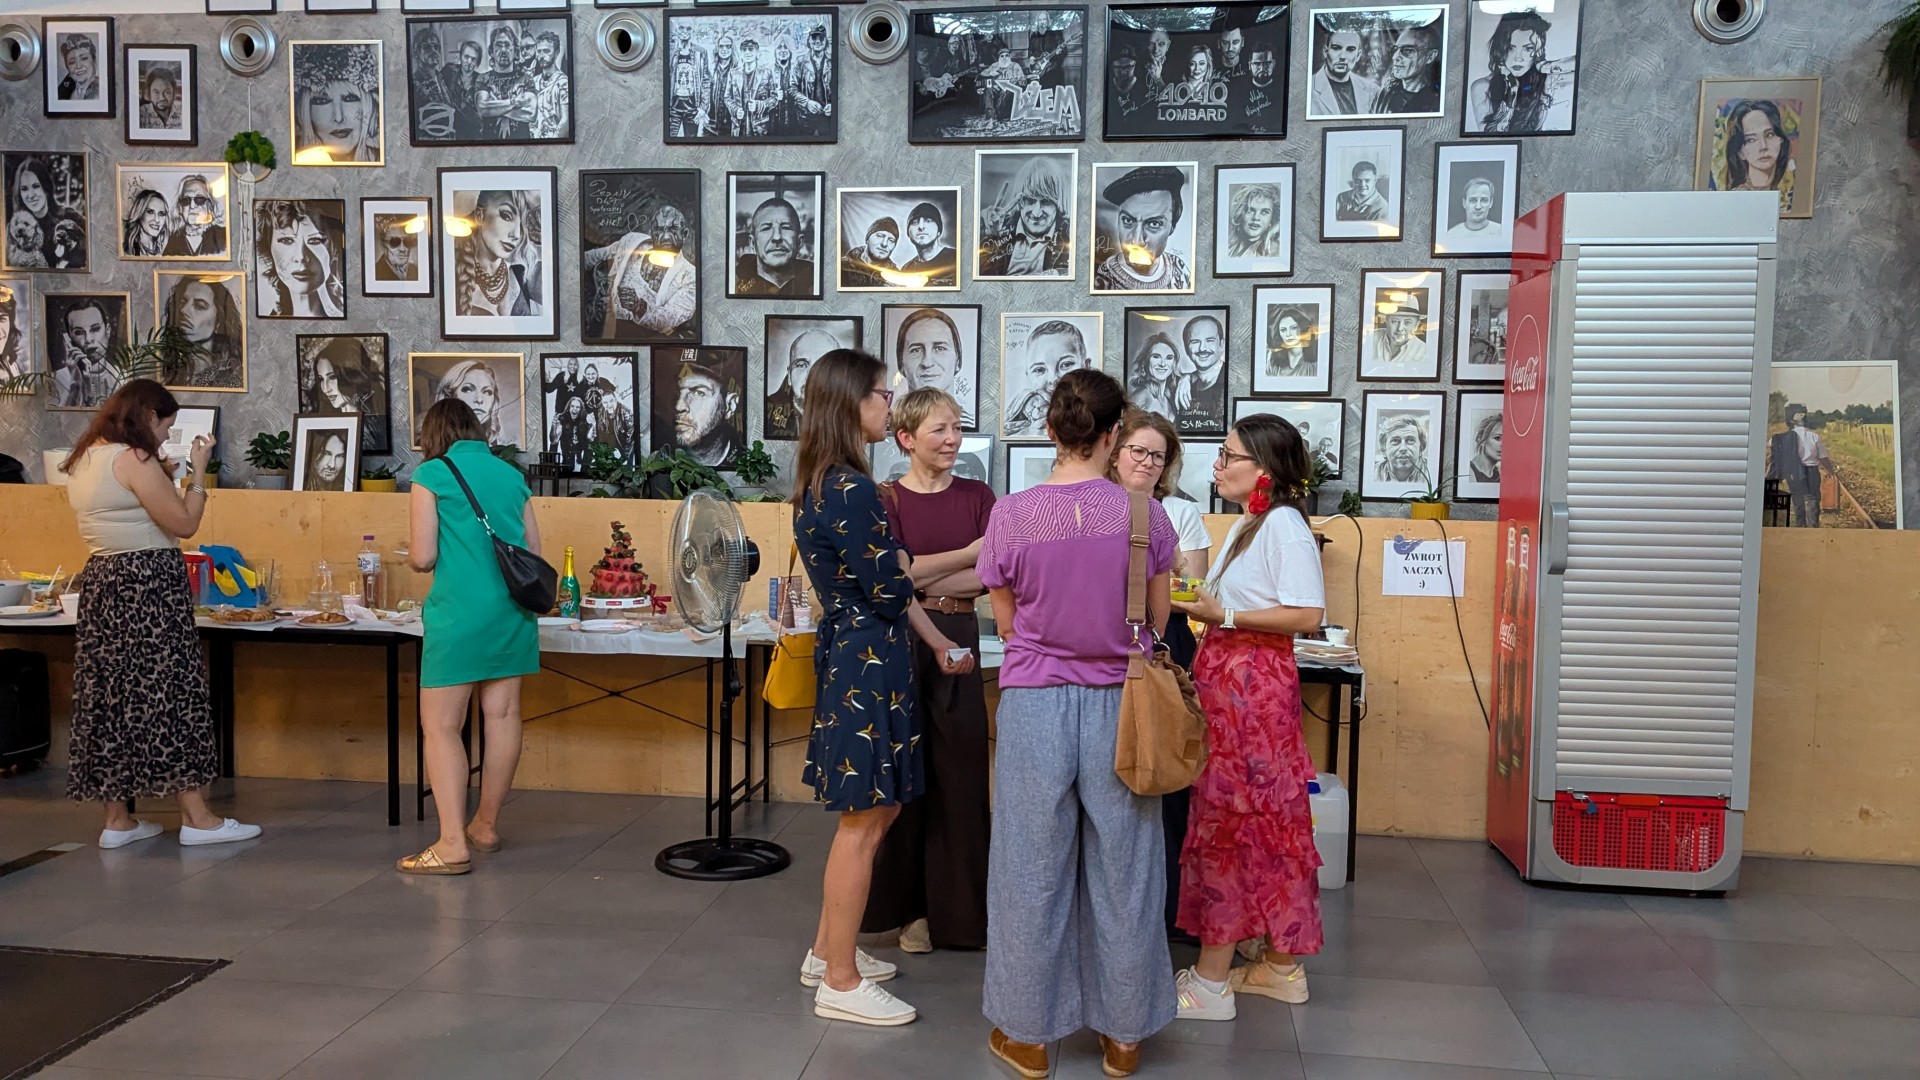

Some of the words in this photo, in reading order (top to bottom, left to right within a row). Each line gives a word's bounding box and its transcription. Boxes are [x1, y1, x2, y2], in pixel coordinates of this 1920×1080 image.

[1157, 108, 1228, 122] LOMBARD
[1404, 553, 1443, 561] ZWROT
[1402, 565, 1443, 575] NACZYŃ
